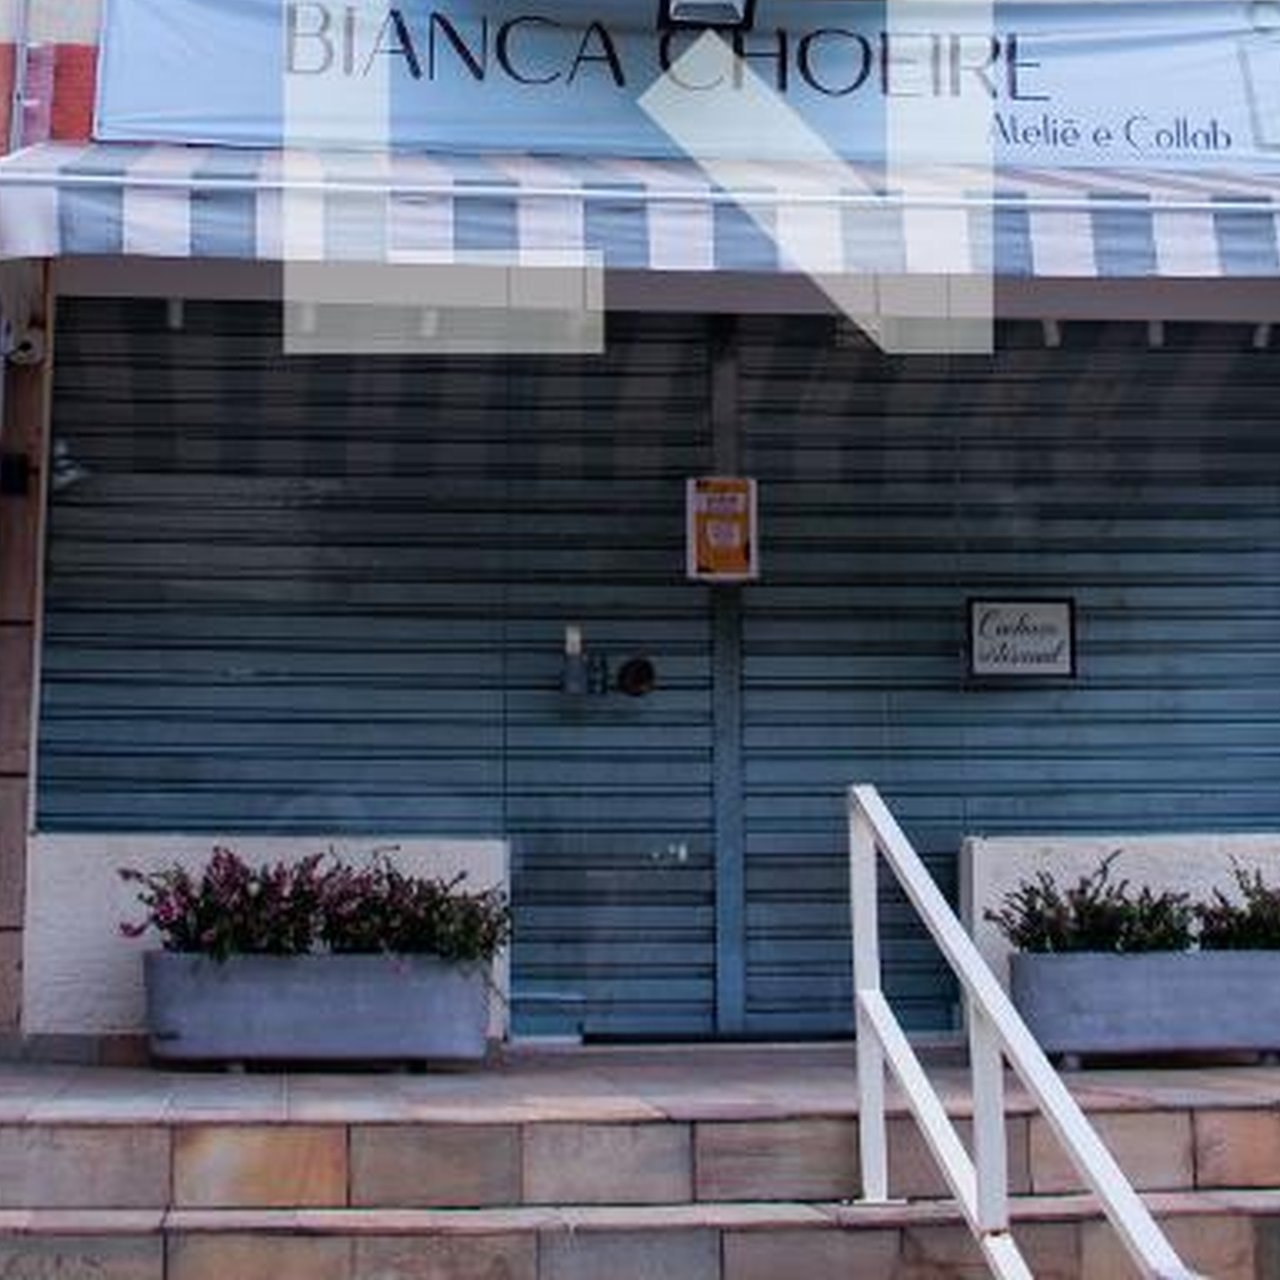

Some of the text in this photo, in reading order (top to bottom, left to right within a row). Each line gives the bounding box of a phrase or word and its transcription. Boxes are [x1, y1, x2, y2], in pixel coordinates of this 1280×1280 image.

[286, 2, 626, 87] BIANCA
[1092, 128, 1114, 148] e
[1124, 115, 1232, 154] Collab
